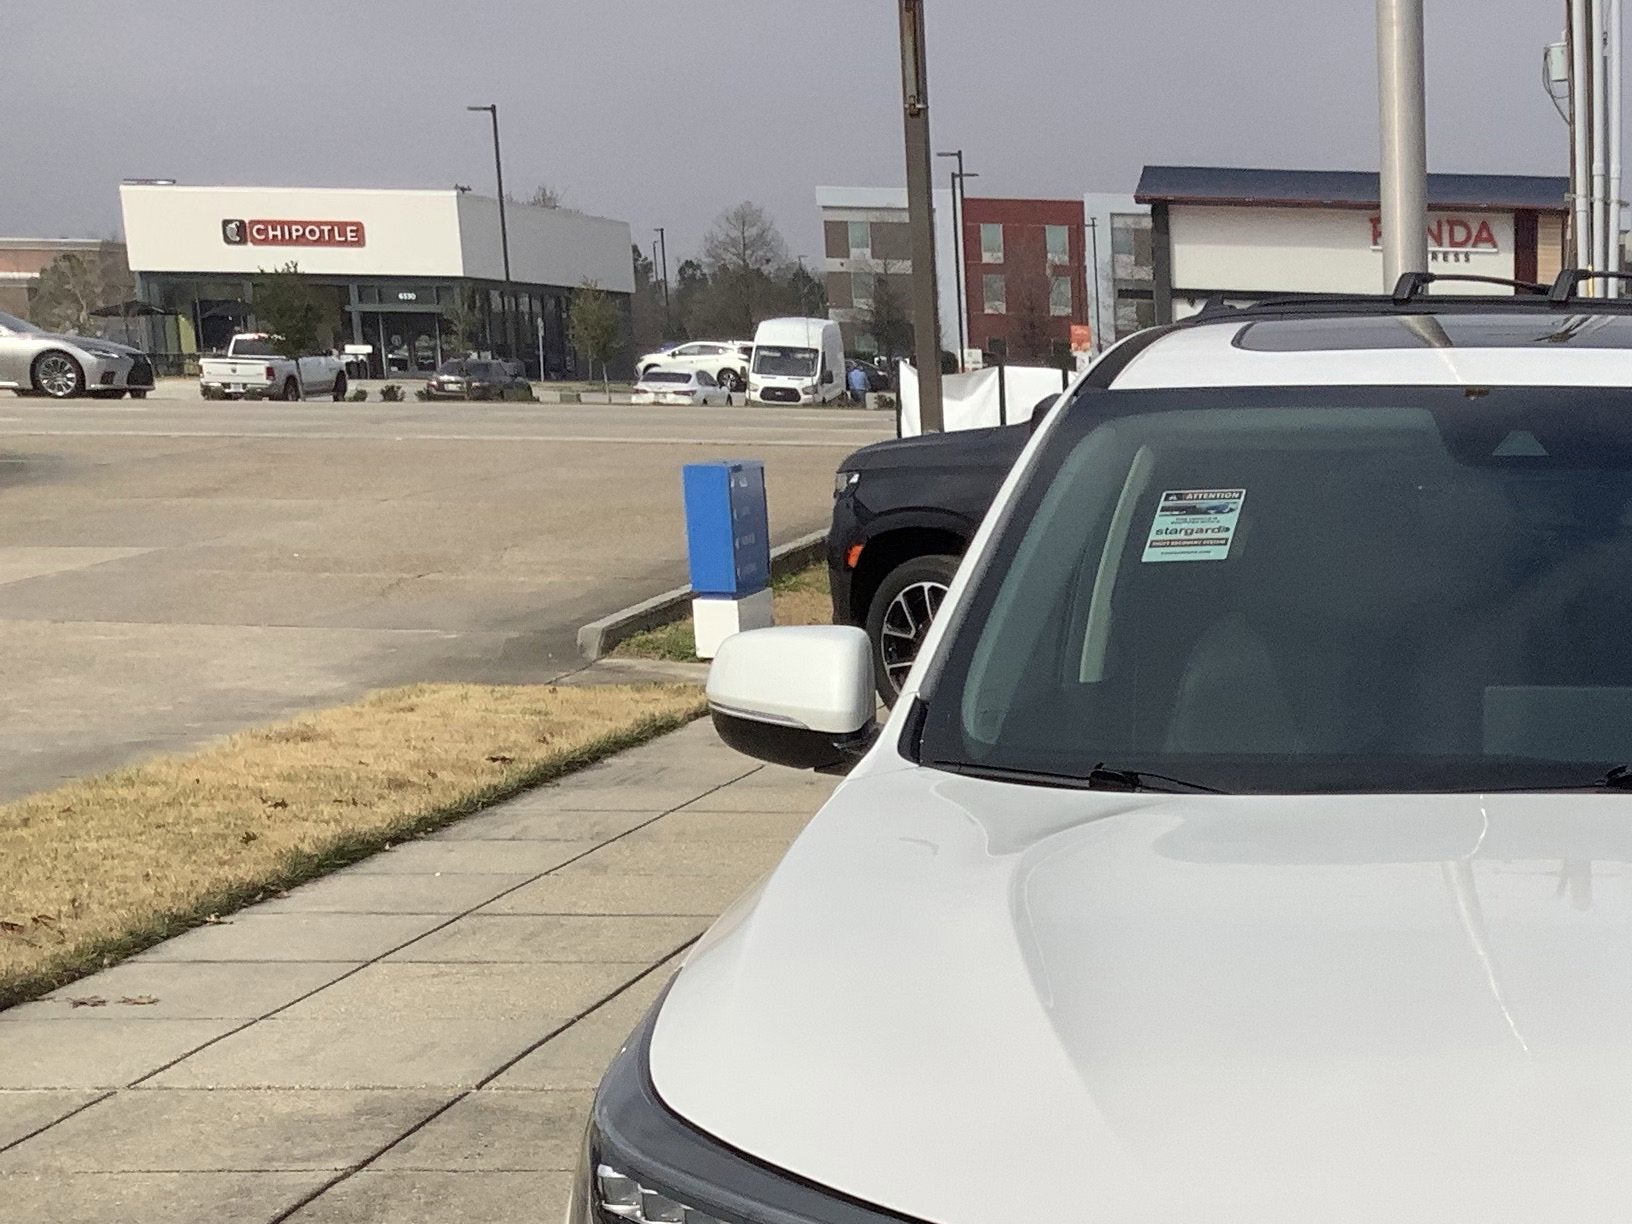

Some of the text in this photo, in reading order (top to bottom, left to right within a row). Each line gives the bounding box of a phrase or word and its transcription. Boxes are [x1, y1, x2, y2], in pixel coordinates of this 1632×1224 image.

[252, 224, 359, 241] CHIPOTLE
[1369, 215, 1498, 249] PNDA
[1186, 492, 1240, 500] ATTENTION
